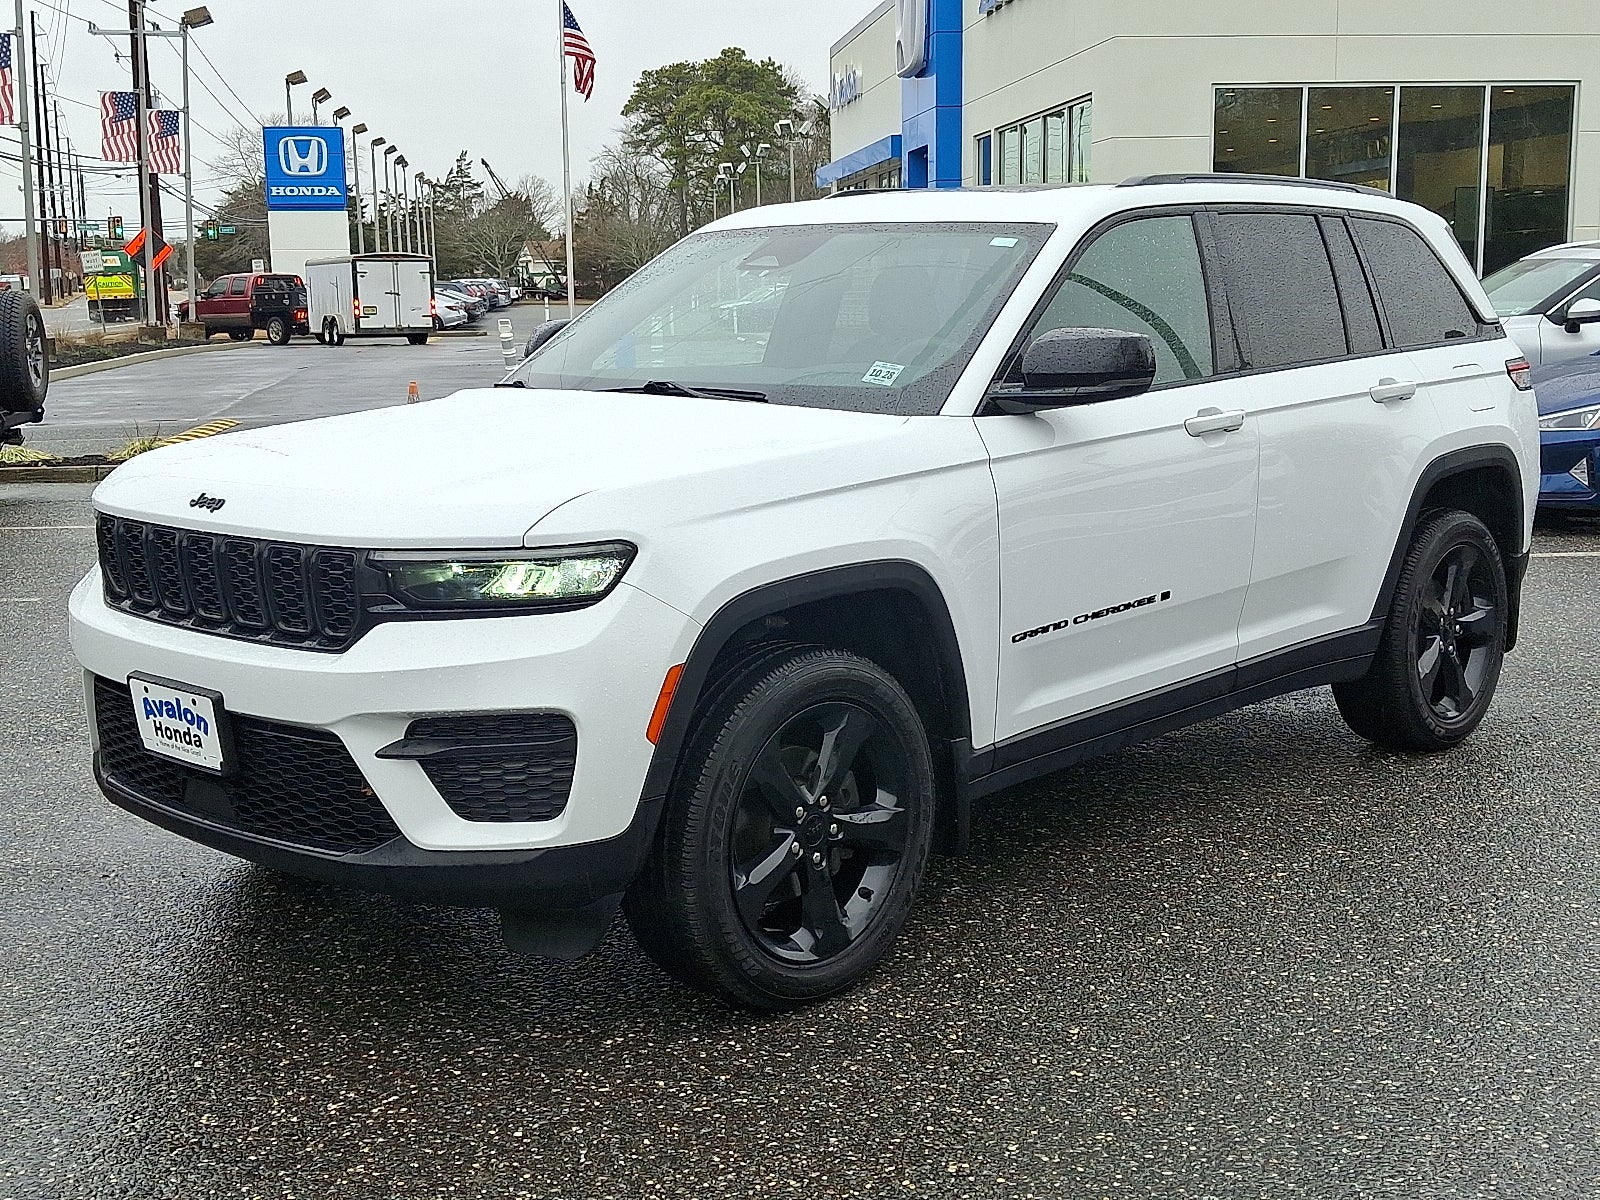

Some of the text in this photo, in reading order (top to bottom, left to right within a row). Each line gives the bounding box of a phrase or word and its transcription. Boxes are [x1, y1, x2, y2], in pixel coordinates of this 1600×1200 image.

[270, 186, 342, 196] HONDA
[189, 492, 226, 513] Jeep
[1011, 594, 1157, 643] GRAND CHEROKEE
[142, 696, 209, 737] Avalon
[152, 719, 203, 749] Honda
